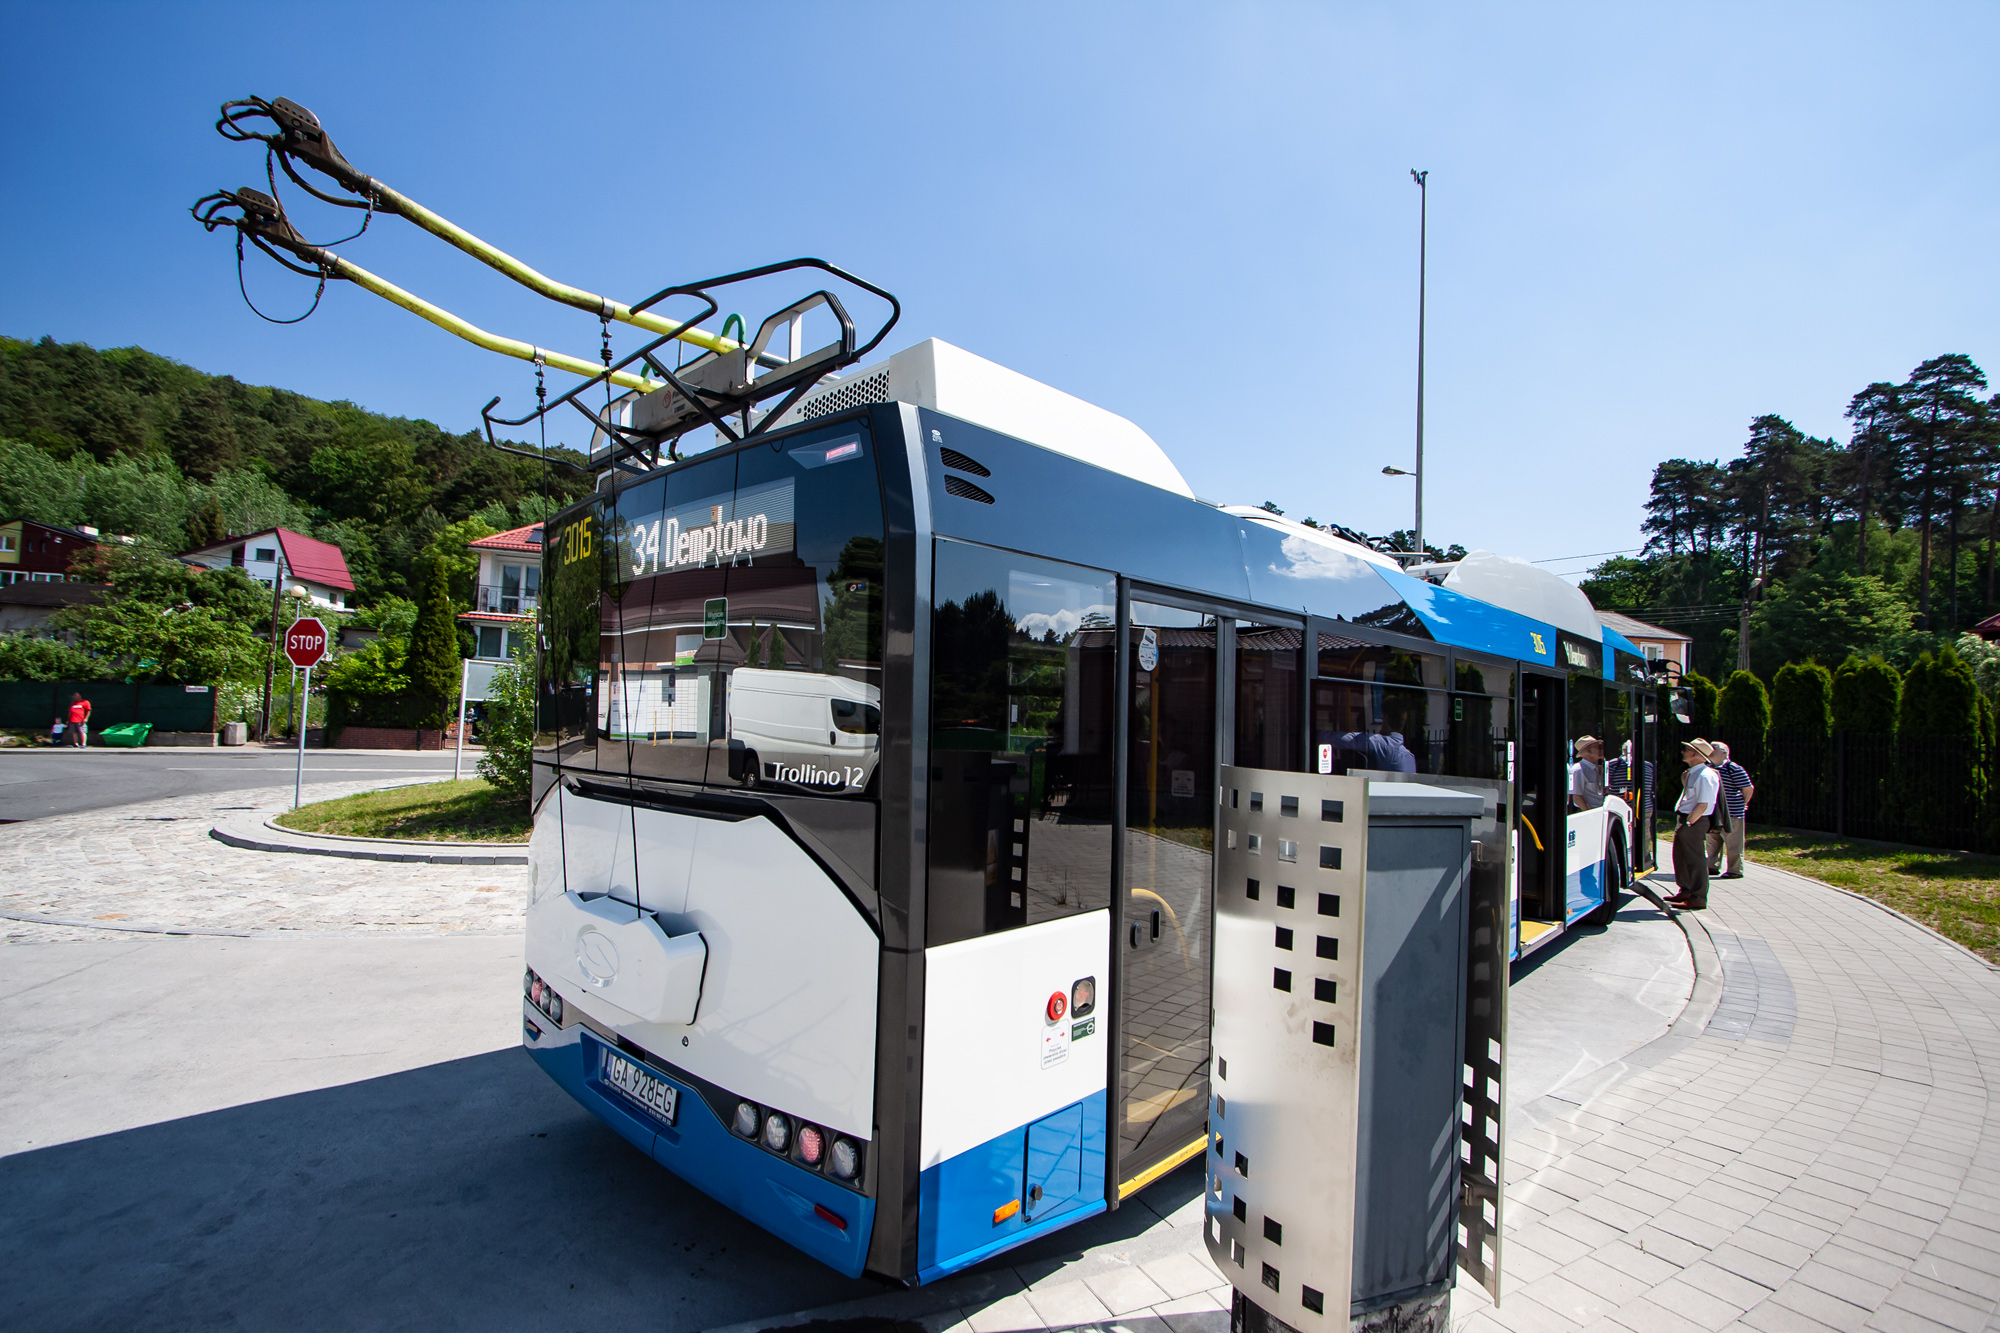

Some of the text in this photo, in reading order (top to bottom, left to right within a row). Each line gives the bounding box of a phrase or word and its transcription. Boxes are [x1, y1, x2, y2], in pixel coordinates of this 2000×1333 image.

[564, 516, 592, 566] 3015
[632, 505, 768, 576] 34 Demptowo
[290, 635, 323, 650] STOP
[772, 761, 865, 788] Trollino 12
[613, 1057, 628, 1088] GA
[632, 1068, 673, 1114] 928EG
